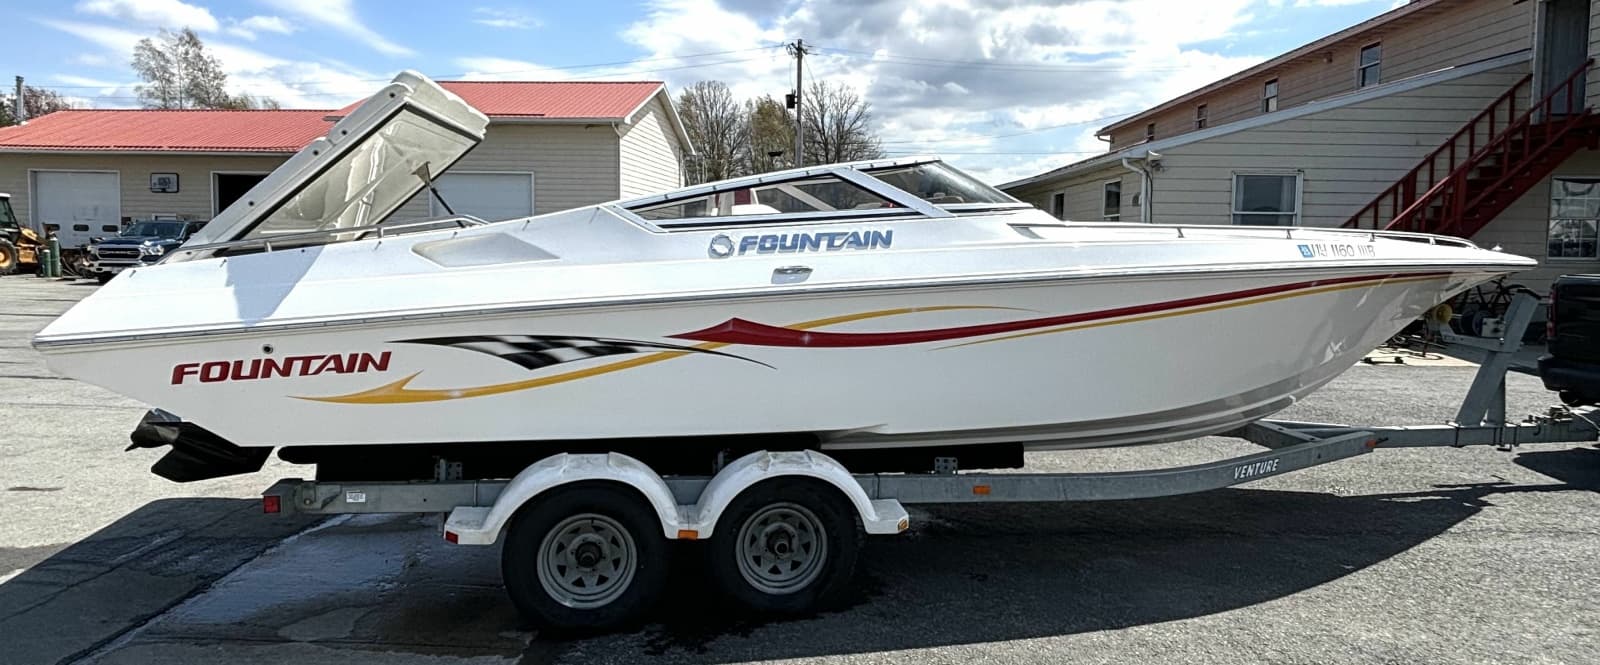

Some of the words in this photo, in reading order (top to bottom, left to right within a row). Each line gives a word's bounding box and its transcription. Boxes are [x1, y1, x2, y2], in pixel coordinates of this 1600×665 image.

[738, 230, 893, 255] FOUNTAIN
[171, 351, 392, 385] FOUNTAIN
[1234, 458, 1280, 480] VENTURE
